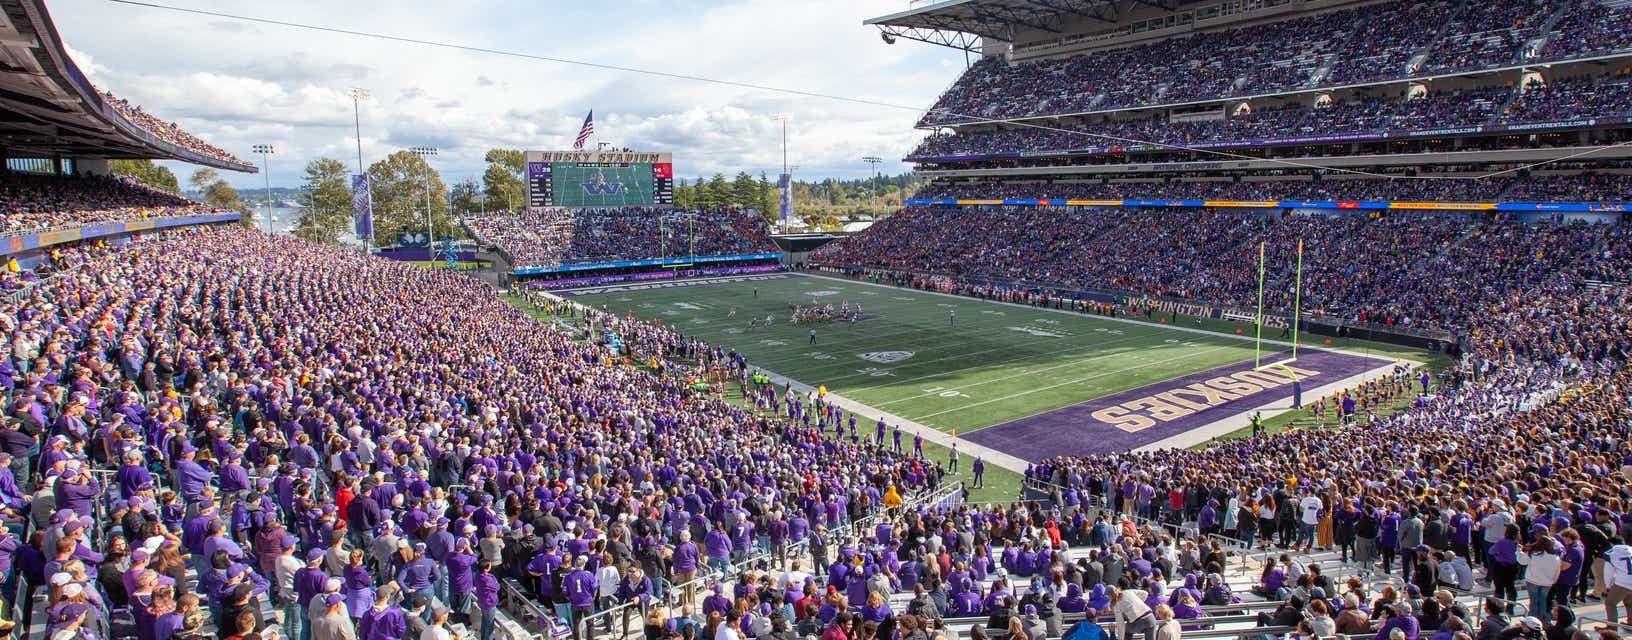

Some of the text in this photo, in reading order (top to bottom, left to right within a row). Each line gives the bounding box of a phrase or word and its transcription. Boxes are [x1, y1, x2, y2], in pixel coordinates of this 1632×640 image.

[542, 152, 660, 162] HUSKY STADIUM
[1091, 365, 1321, 433] HUSKIES
[737, 526, 745, 537] 7
[545, 562, 551, 575] 1
[575, 579, 583, 593] 1
[967, 599, 972, 612] 1
